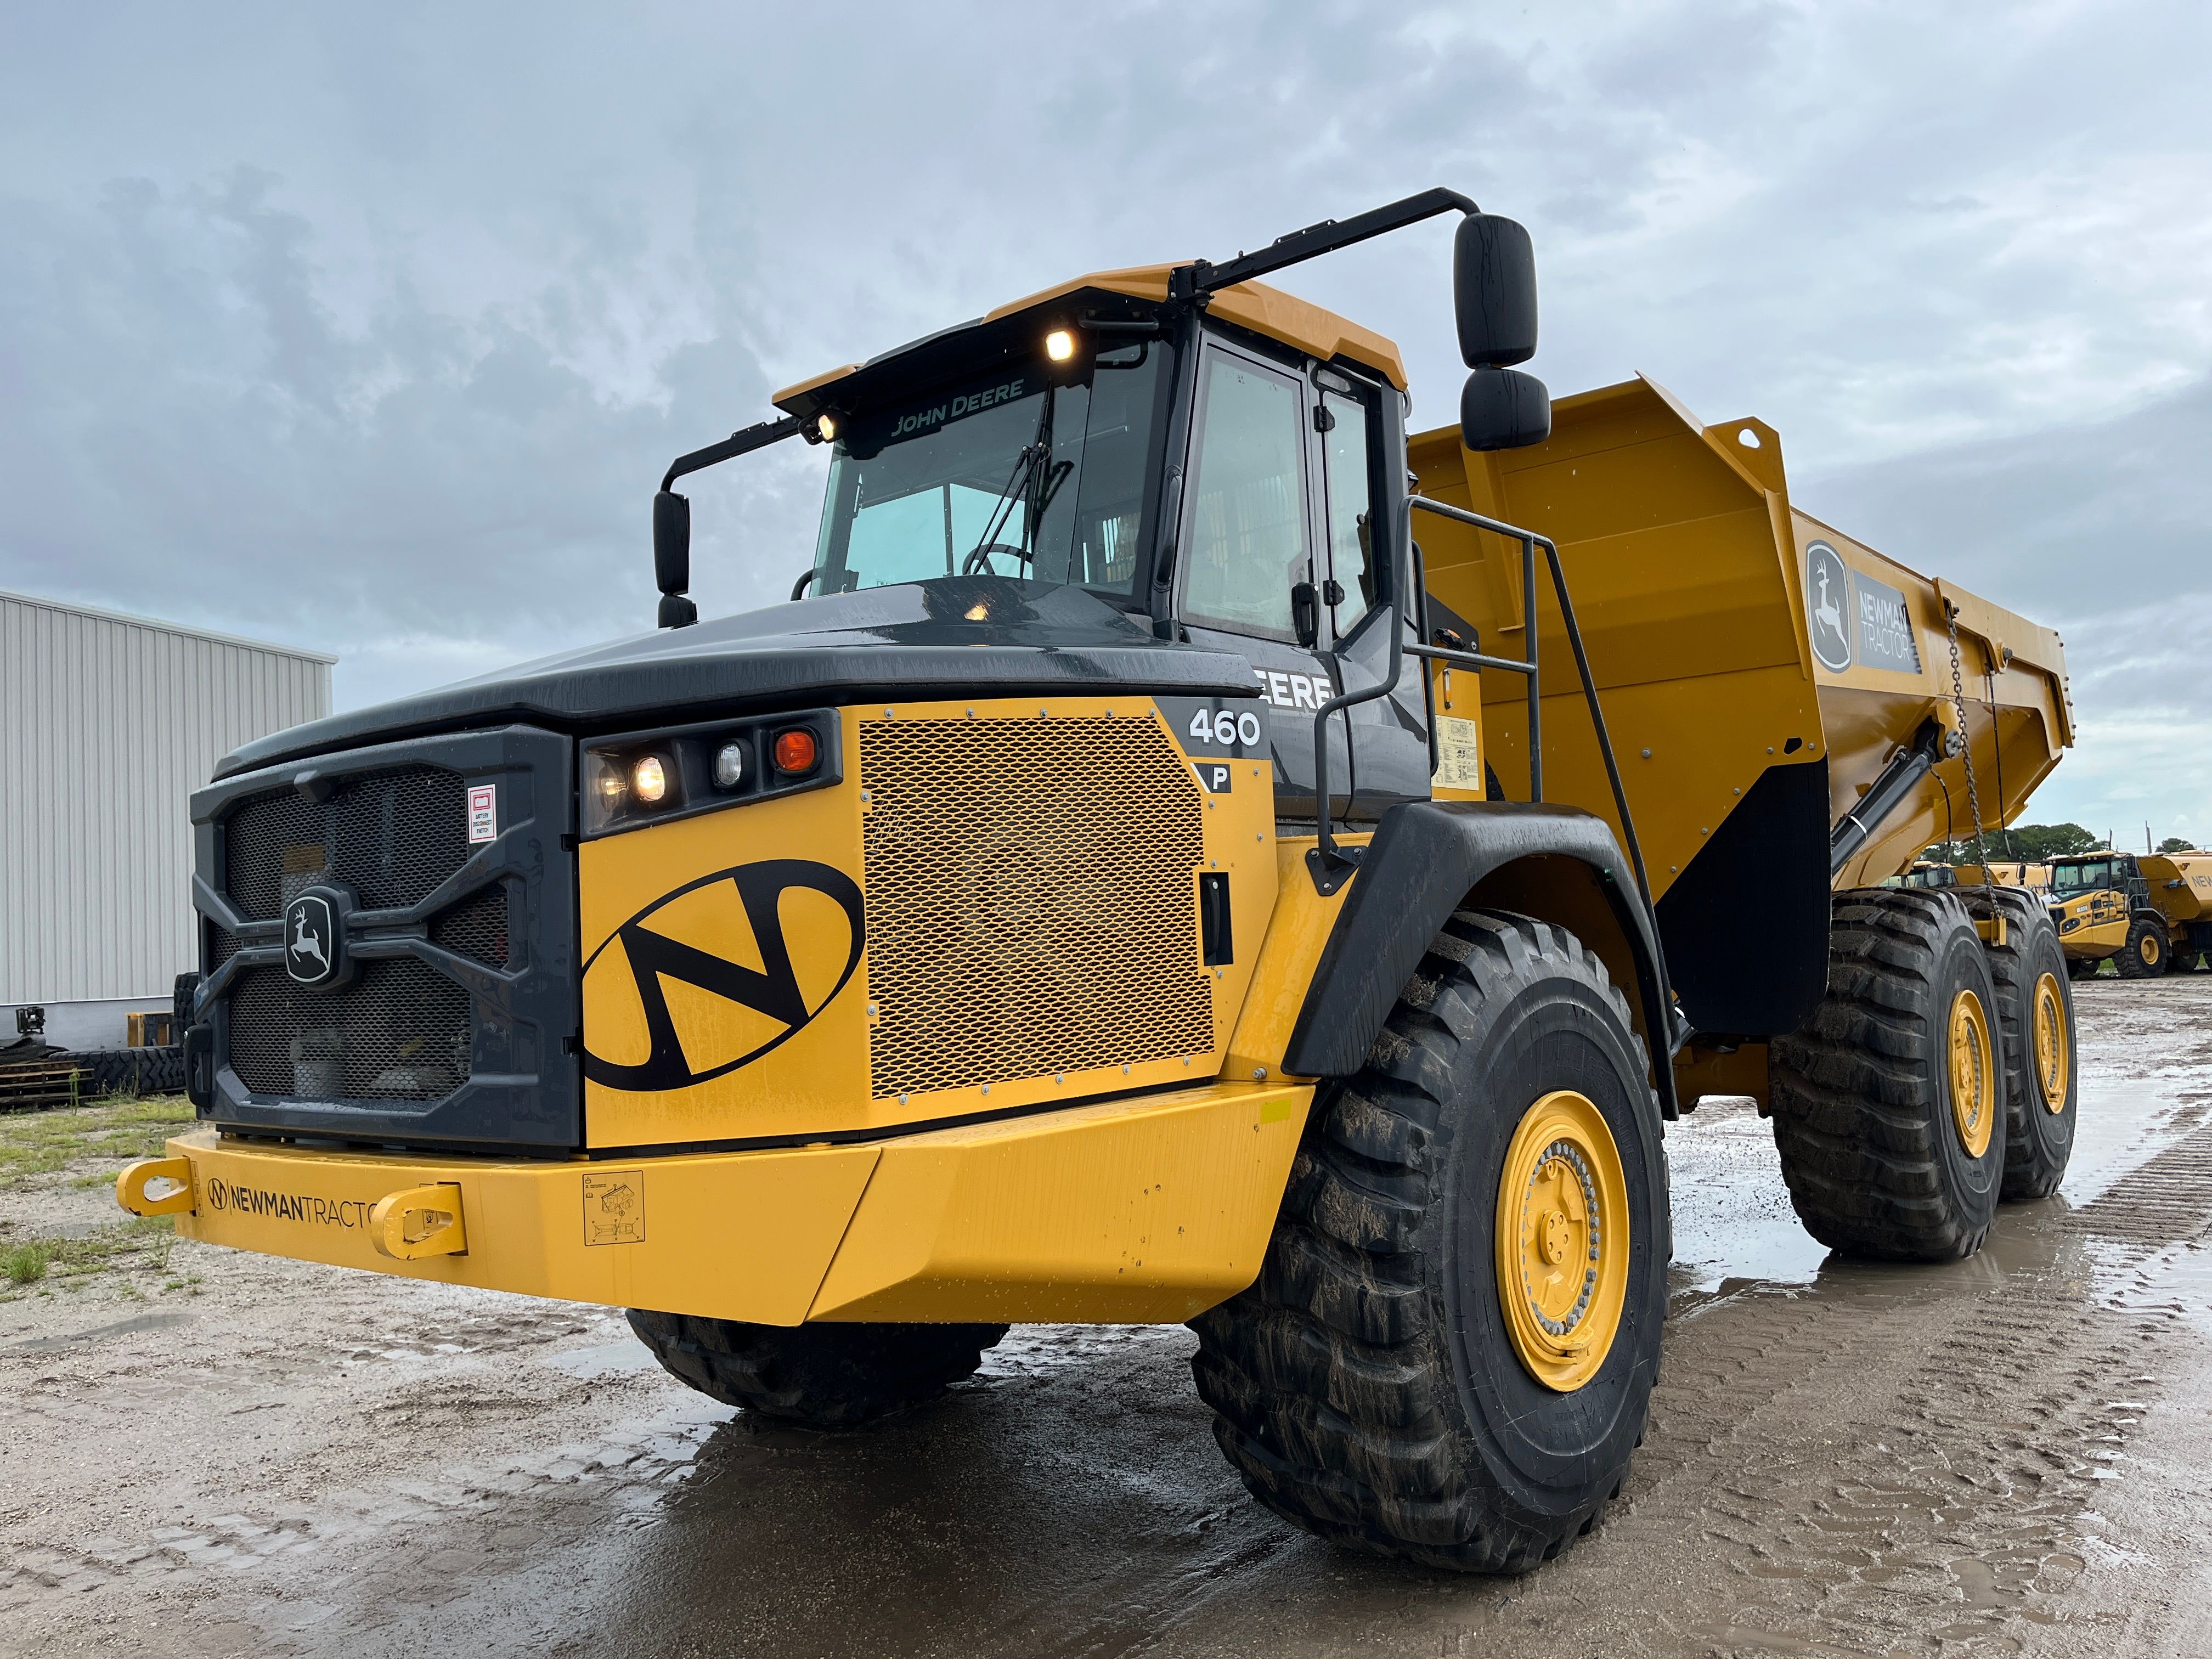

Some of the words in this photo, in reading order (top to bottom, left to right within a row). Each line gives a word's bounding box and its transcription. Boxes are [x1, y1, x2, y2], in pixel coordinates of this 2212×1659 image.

[891, 404, 947, 437] JOHN
[951, 379, 1024, 417] DEERE
[1859, 590, 1908, 634] NEWMAN
[1861, 620, 1911, 661] TRACTOR
[1189, 709, 1260, 746] 460
[1212, 767, 1228, 789] P
